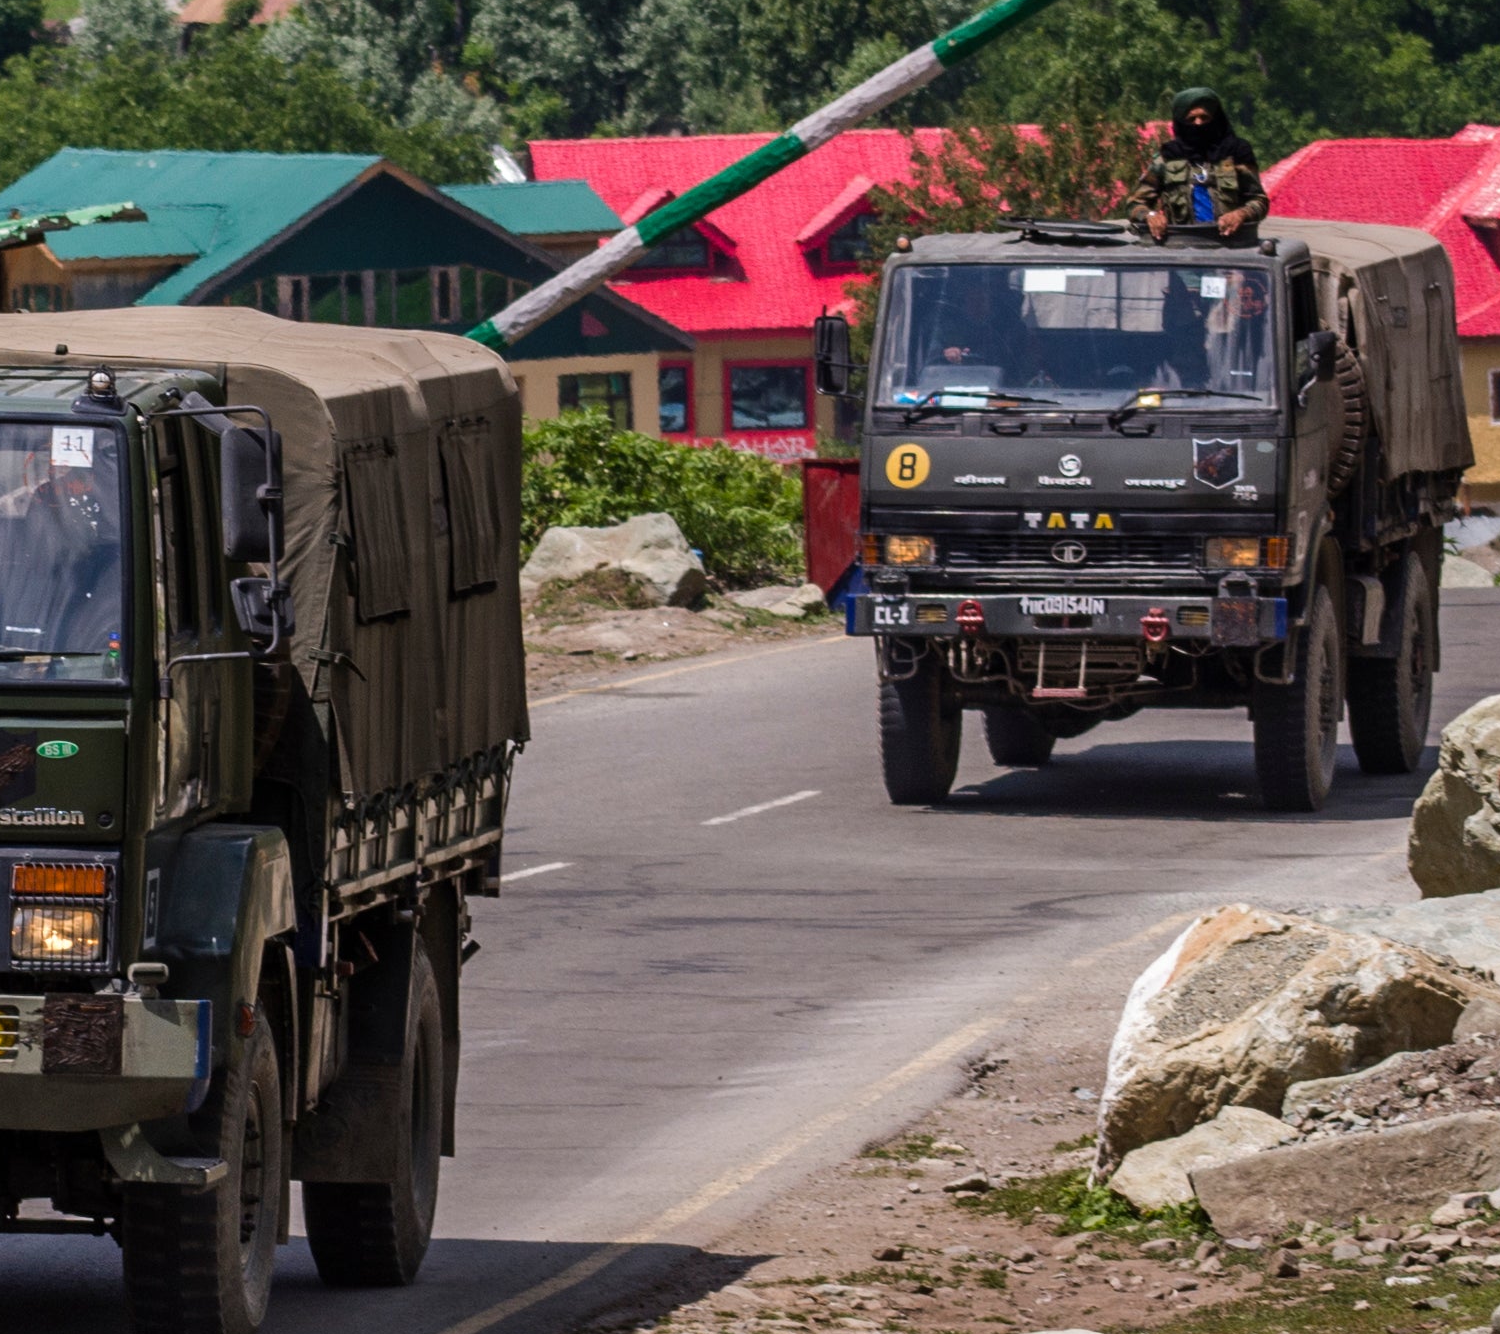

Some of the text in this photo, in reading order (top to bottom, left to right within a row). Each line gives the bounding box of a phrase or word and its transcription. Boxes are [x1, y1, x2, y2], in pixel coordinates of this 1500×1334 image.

[63, 435, 84, 452] 11
[898, 452, 917, 481] 8
[1023, 511, 1115, 530] TATA
[45, 744, 60, 756] BS
[0, 807, 85, 826] Stallion
